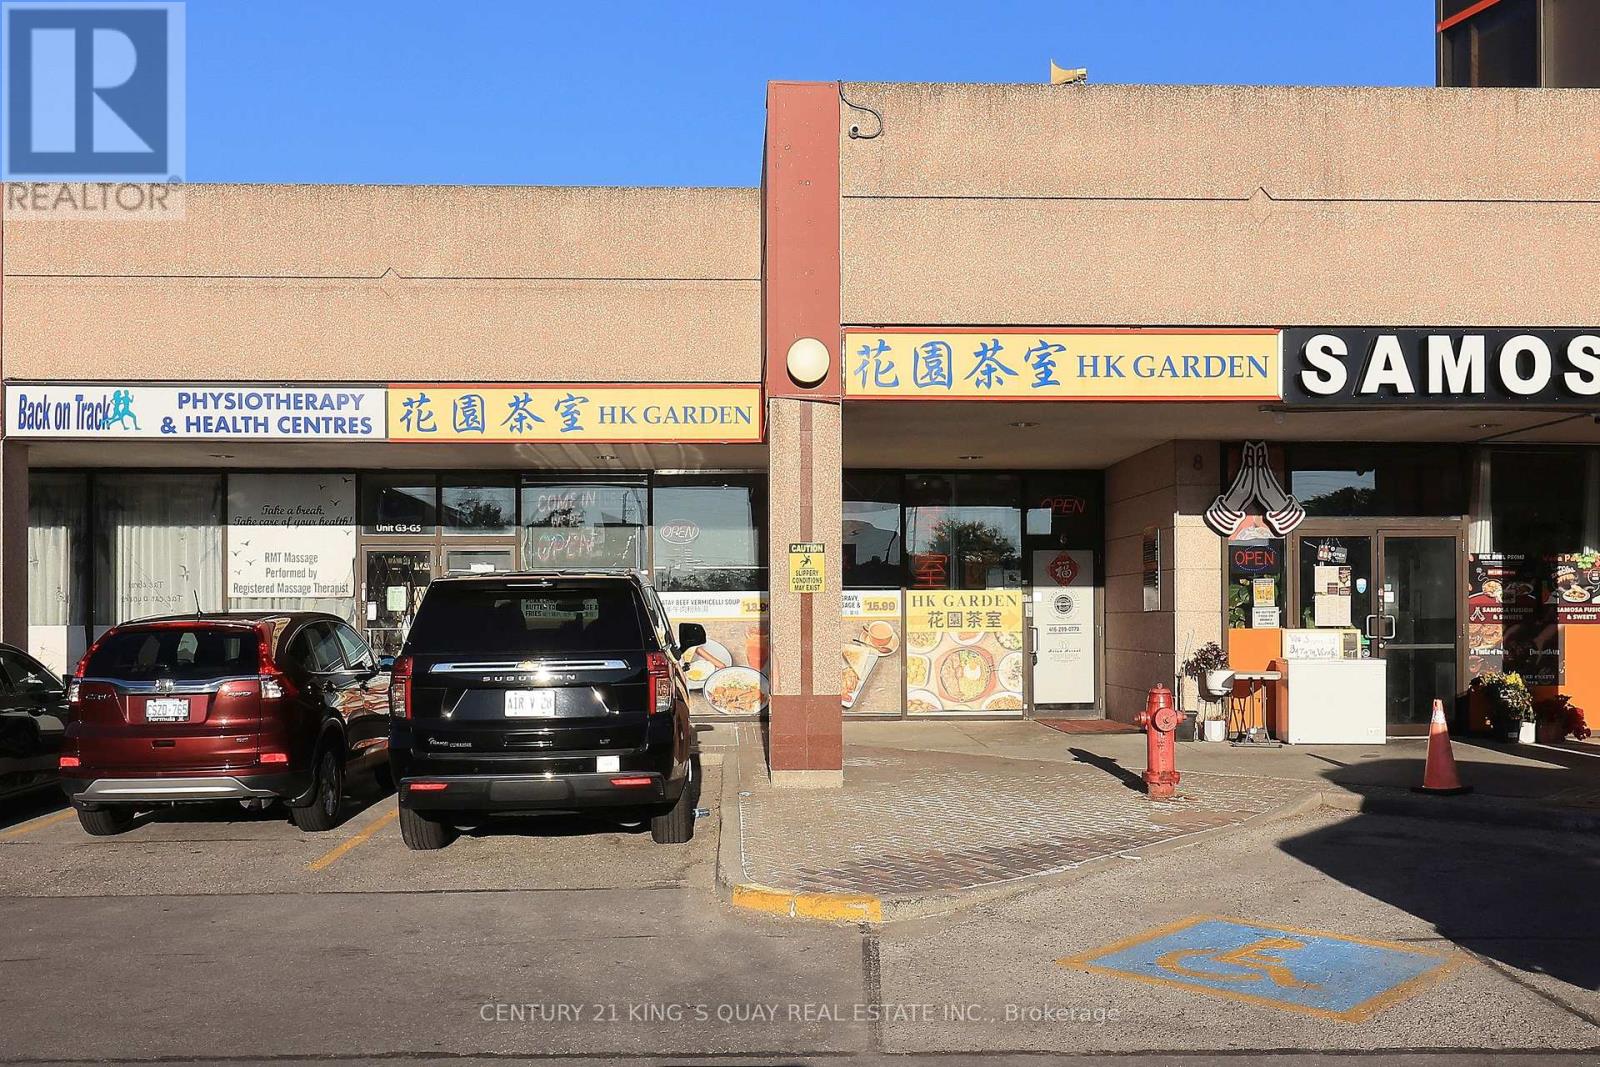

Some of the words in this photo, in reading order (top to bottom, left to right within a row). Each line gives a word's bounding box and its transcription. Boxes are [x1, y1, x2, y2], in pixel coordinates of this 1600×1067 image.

[853, 338, 1067, 390] 花園茶室
[1076, 355, 1125, 379] HK
[1132, 354, 1270, 380] GARDEN
[177, 392, 366, 411] PHYSIOTHERAPY
[18, 393, 51, 431] Back
[54, 401, 71, 431] on
[75, 394, 112, 431] Track
[399, 392, 590, 434] 花園茶室
[598, 406, 637, 425] HK
[643, 405, 753, 425] GARDEN
[160, 417, 177, 434] &
[185, 416, 269, 434] HEALTH
[277, 416, 373, 435] CENTRES
[261, 504, 285, 516] Take
[286, 507, 294, 515] a
[296, 504, 325, 516] break.
[1040, 498, 1087, 513] OPEN
[233, 516, 257, 526] Take
[259, 518, 279, 527] care
[281, 516, 293, 528] of
[293, 518, 316, 529] your
[317, 516, 353, 527] health!
[376, 524, 394, 532] Unit
[395, 524, 422, 533] G3-G5
[662, 525, 696, 538] OPEN
[791, 544, 824, 553] CAUTION
[264, 552, 282, 563] RMT
[284, 552, 319, 565] Massage
[1234, 550, 1276, 566] OPEN
[265, 567, 306, 579] Performed
[308, 567, 318, 580] by
[795, 569, 819, 577] SLIPPERY
[233, 583, 275, 596] Registered
[277, 583, 312, 596] Massage
[313, 583, 349, 596] Therapist
[805, 584, 821, 592] EXIST
[690, 598, 724, 606] VERMICELLI
[863, 600, 897, 612] $15.99
[912, 594, 936, 608] HK
[943, 594, 1018, 608] GARDEN
[927, 610, 1003, 629] 花園茶室
[173, 704, 188, 715] 765
